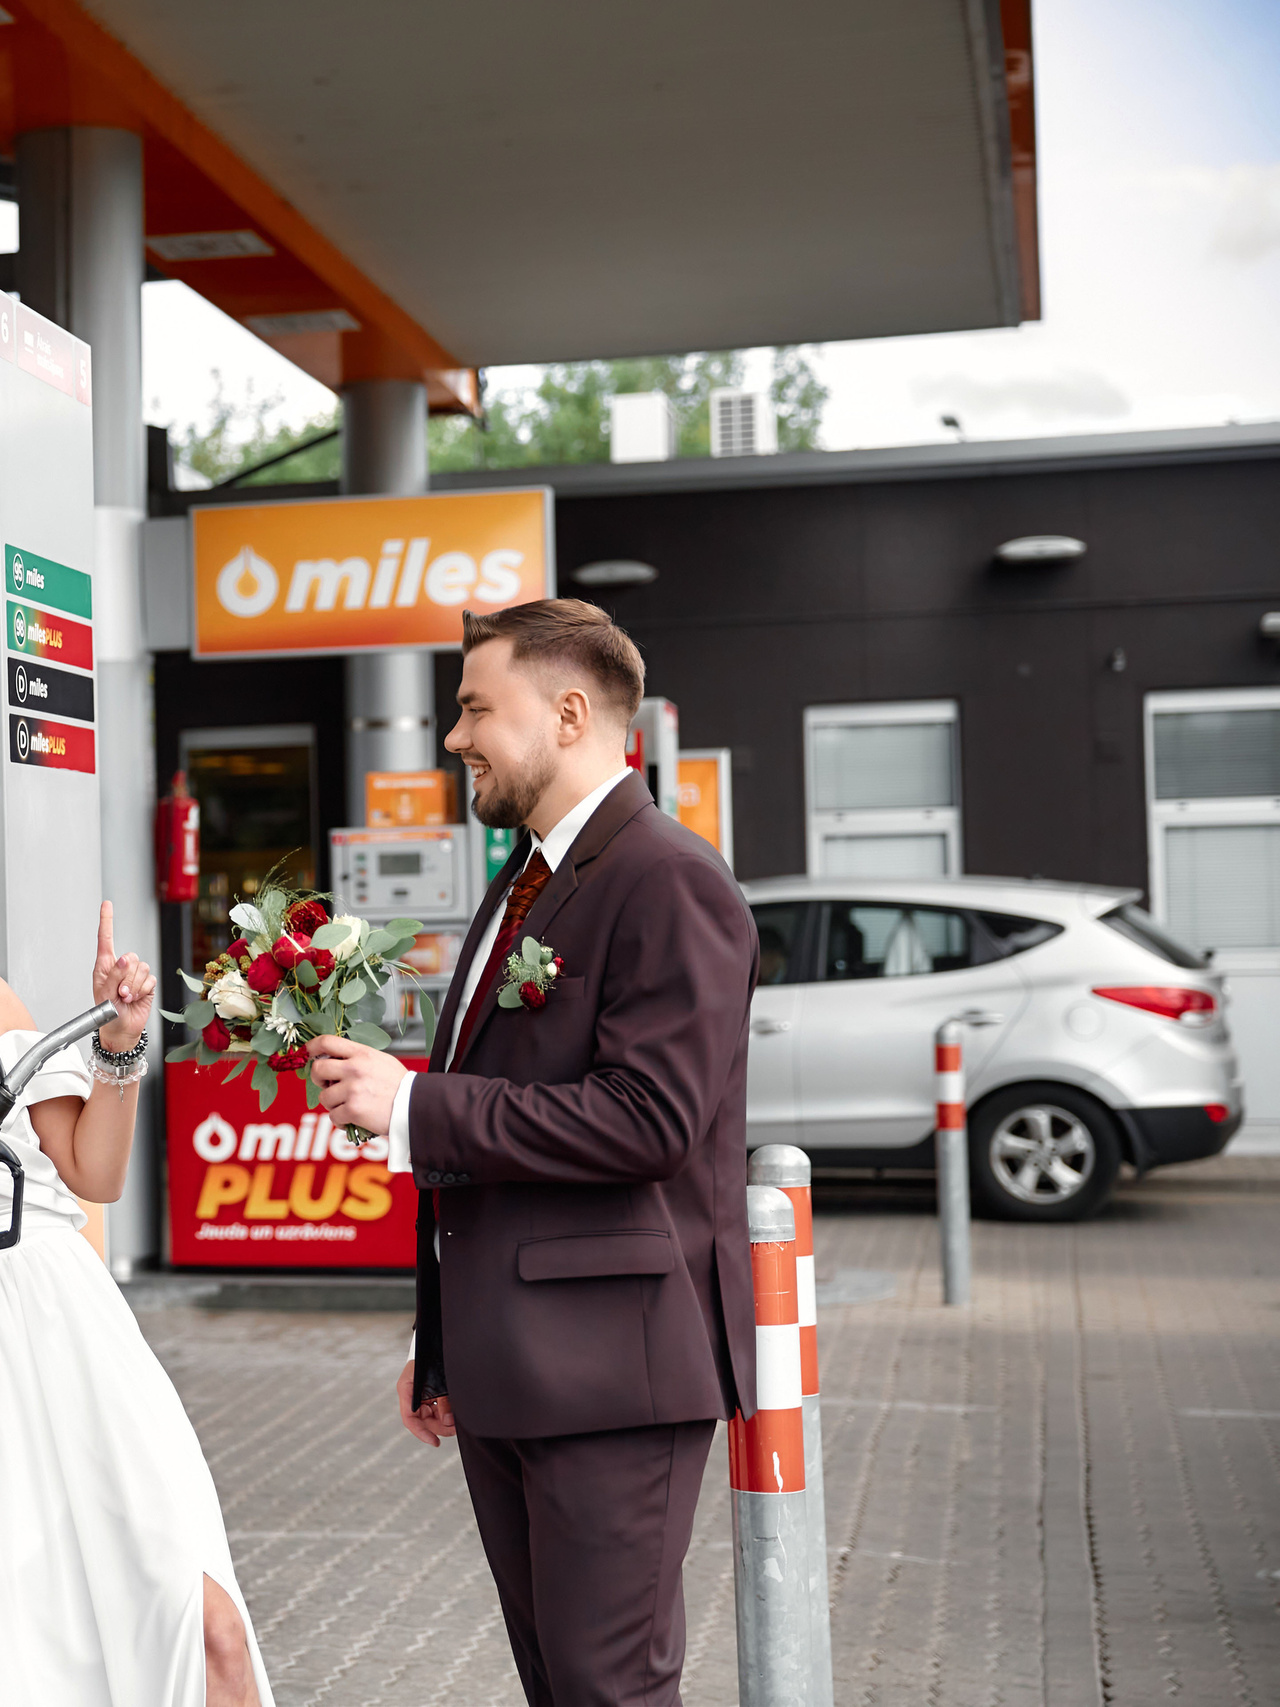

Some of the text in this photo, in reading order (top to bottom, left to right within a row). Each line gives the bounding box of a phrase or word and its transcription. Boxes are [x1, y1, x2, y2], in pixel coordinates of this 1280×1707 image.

[1, 311, 9, 344] 6
[14, 561, 44, 589] 95 miles
[285, 537, 524, 613] miles
[15, 618, 25, 637] 98
[18, 674, 48, 699] D miles
[20, 730, 27, 749] D
[195, 1164, 394, 1221] PLUS
